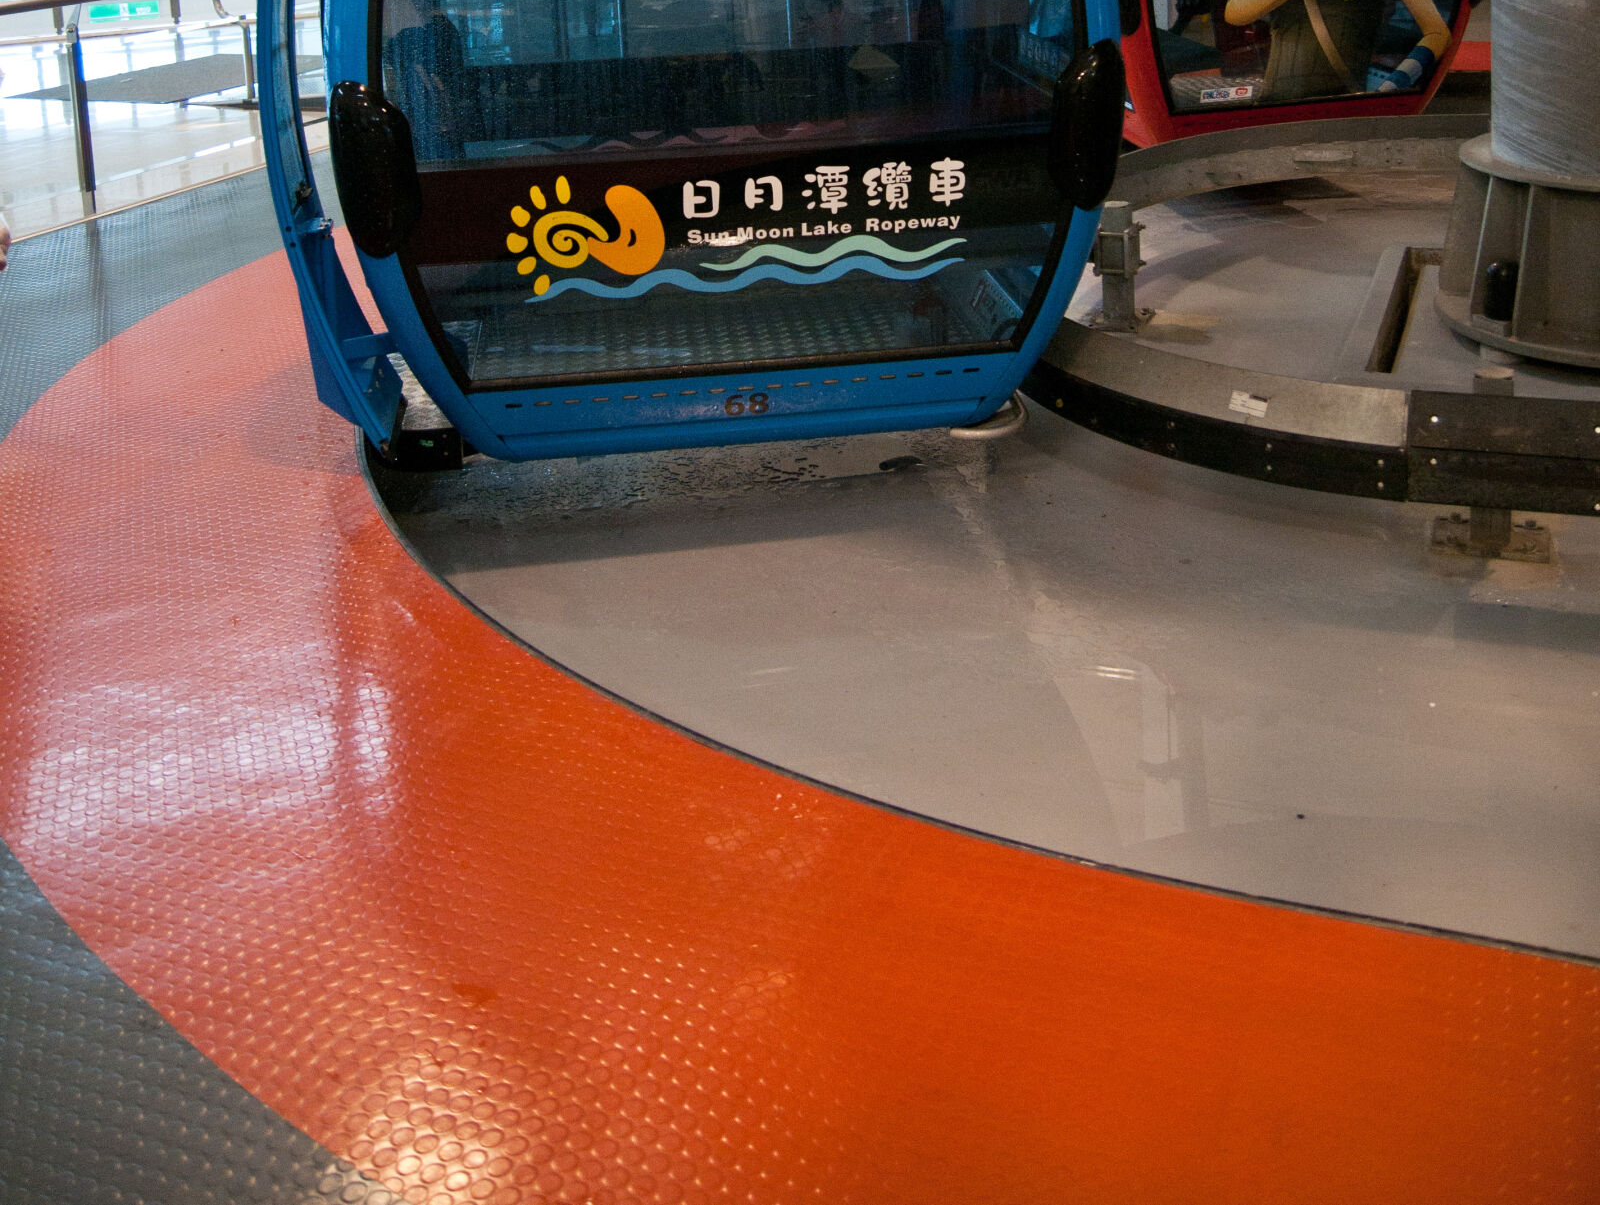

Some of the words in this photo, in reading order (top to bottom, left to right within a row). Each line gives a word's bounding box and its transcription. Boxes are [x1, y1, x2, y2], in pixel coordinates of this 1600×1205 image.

[682, 156, 967, 220] 日月潭纜車
[687, 229, 730, 244] Sun
[736, 226, 794, 241] Moon
[801, 220, 853, 237] Lake
[865, 215, 961, 234] Ropeway
[724, 392, 769, 417] 68
